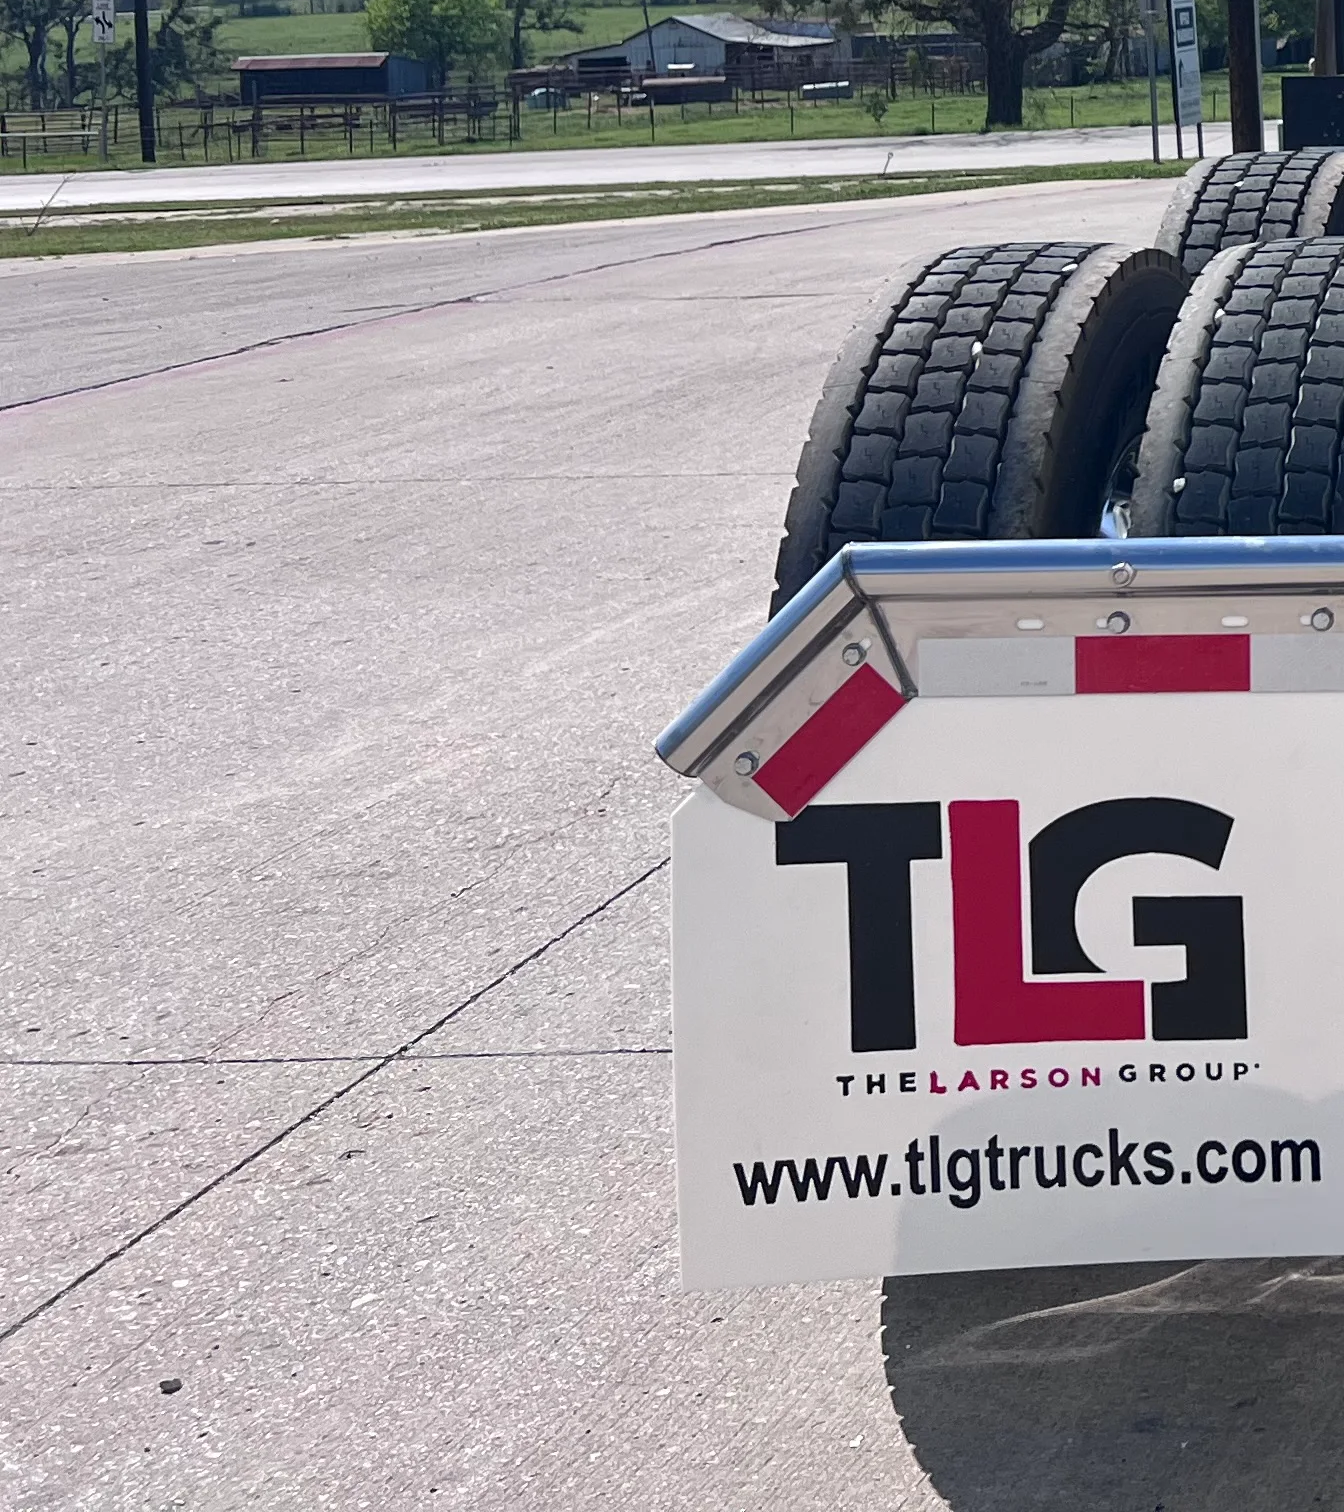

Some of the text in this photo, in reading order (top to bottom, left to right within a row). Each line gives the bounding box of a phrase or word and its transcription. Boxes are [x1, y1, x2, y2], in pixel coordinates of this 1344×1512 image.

[775, 796, 1249, 1053] TLG
[836, 1062, 1249, 1097] THE LARSON GROUP
[732, 1127, 1322, 1210] www.tlgtrucks.com
